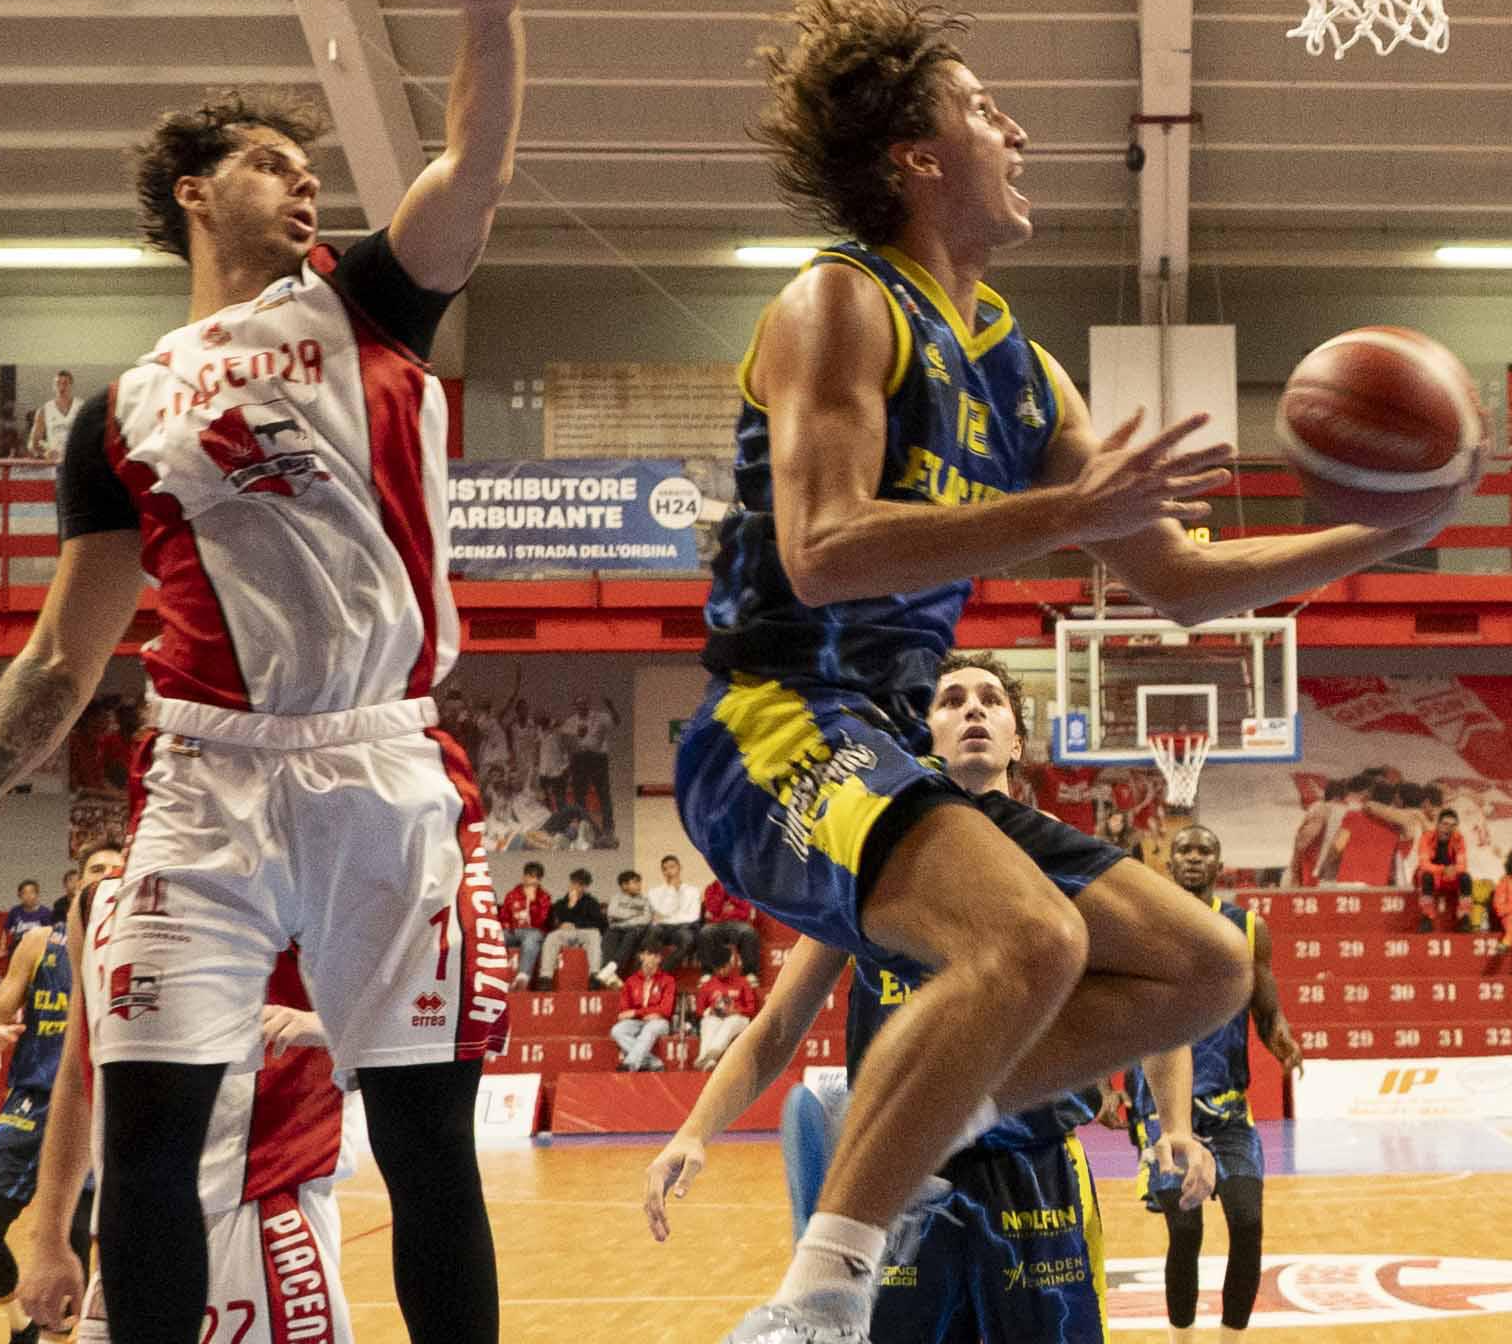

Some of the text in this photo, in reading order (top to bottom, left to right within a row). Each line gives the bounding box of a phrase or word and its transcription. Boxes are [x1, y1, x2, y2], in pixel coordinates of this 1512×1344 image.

[957, 391, 992, 458] 12
[448, 478, 637, 500] ISTRIBUTORE
[448, 506, 623, 528] ARBURANTE
[655, 499, 697, 515] H24
[447, 545, 508, 559] ACENZA
[514, 544, 578, 558] STRADA
[1294, 898, 1317, 913] 28
[1337, 897, 1360, 912] 29
[1381, 897, 1404, 912] 30
[429, 906, 449, 980] 1
[1296, 941, 1320, 958] 28
[1340, 941, 1364, 957] 29
[1386, 941, 1409, 956] 30
[1428, 940, 1450, 956] 31
[1300, 986, 1324, 1002] 28
[1345, 985, 1368, 1001] 29
[1391, 985, 1414, 1000] 30
[1433, 984, 1455, 1001] 31
[1480, 983, 1503, 1000] 32
[533, 997, 602, 1015] 15 16
[412, 1015, 446, 1026] errea
[1302, 1032, 1328, 1048] 28
[1348, 1031, 1373, 1048] 29
[1396, 1030, 1420, 1046] 30
[1440, 1029, 1462, 1046] 31
[1487, 1028, 1511, 1045] 32
[522, 1040, 829, 1062] 15 16 21
[1379, 1069, 1438, 1094] IP
[1001, 1205, 1077, 1231] NOLFIN
